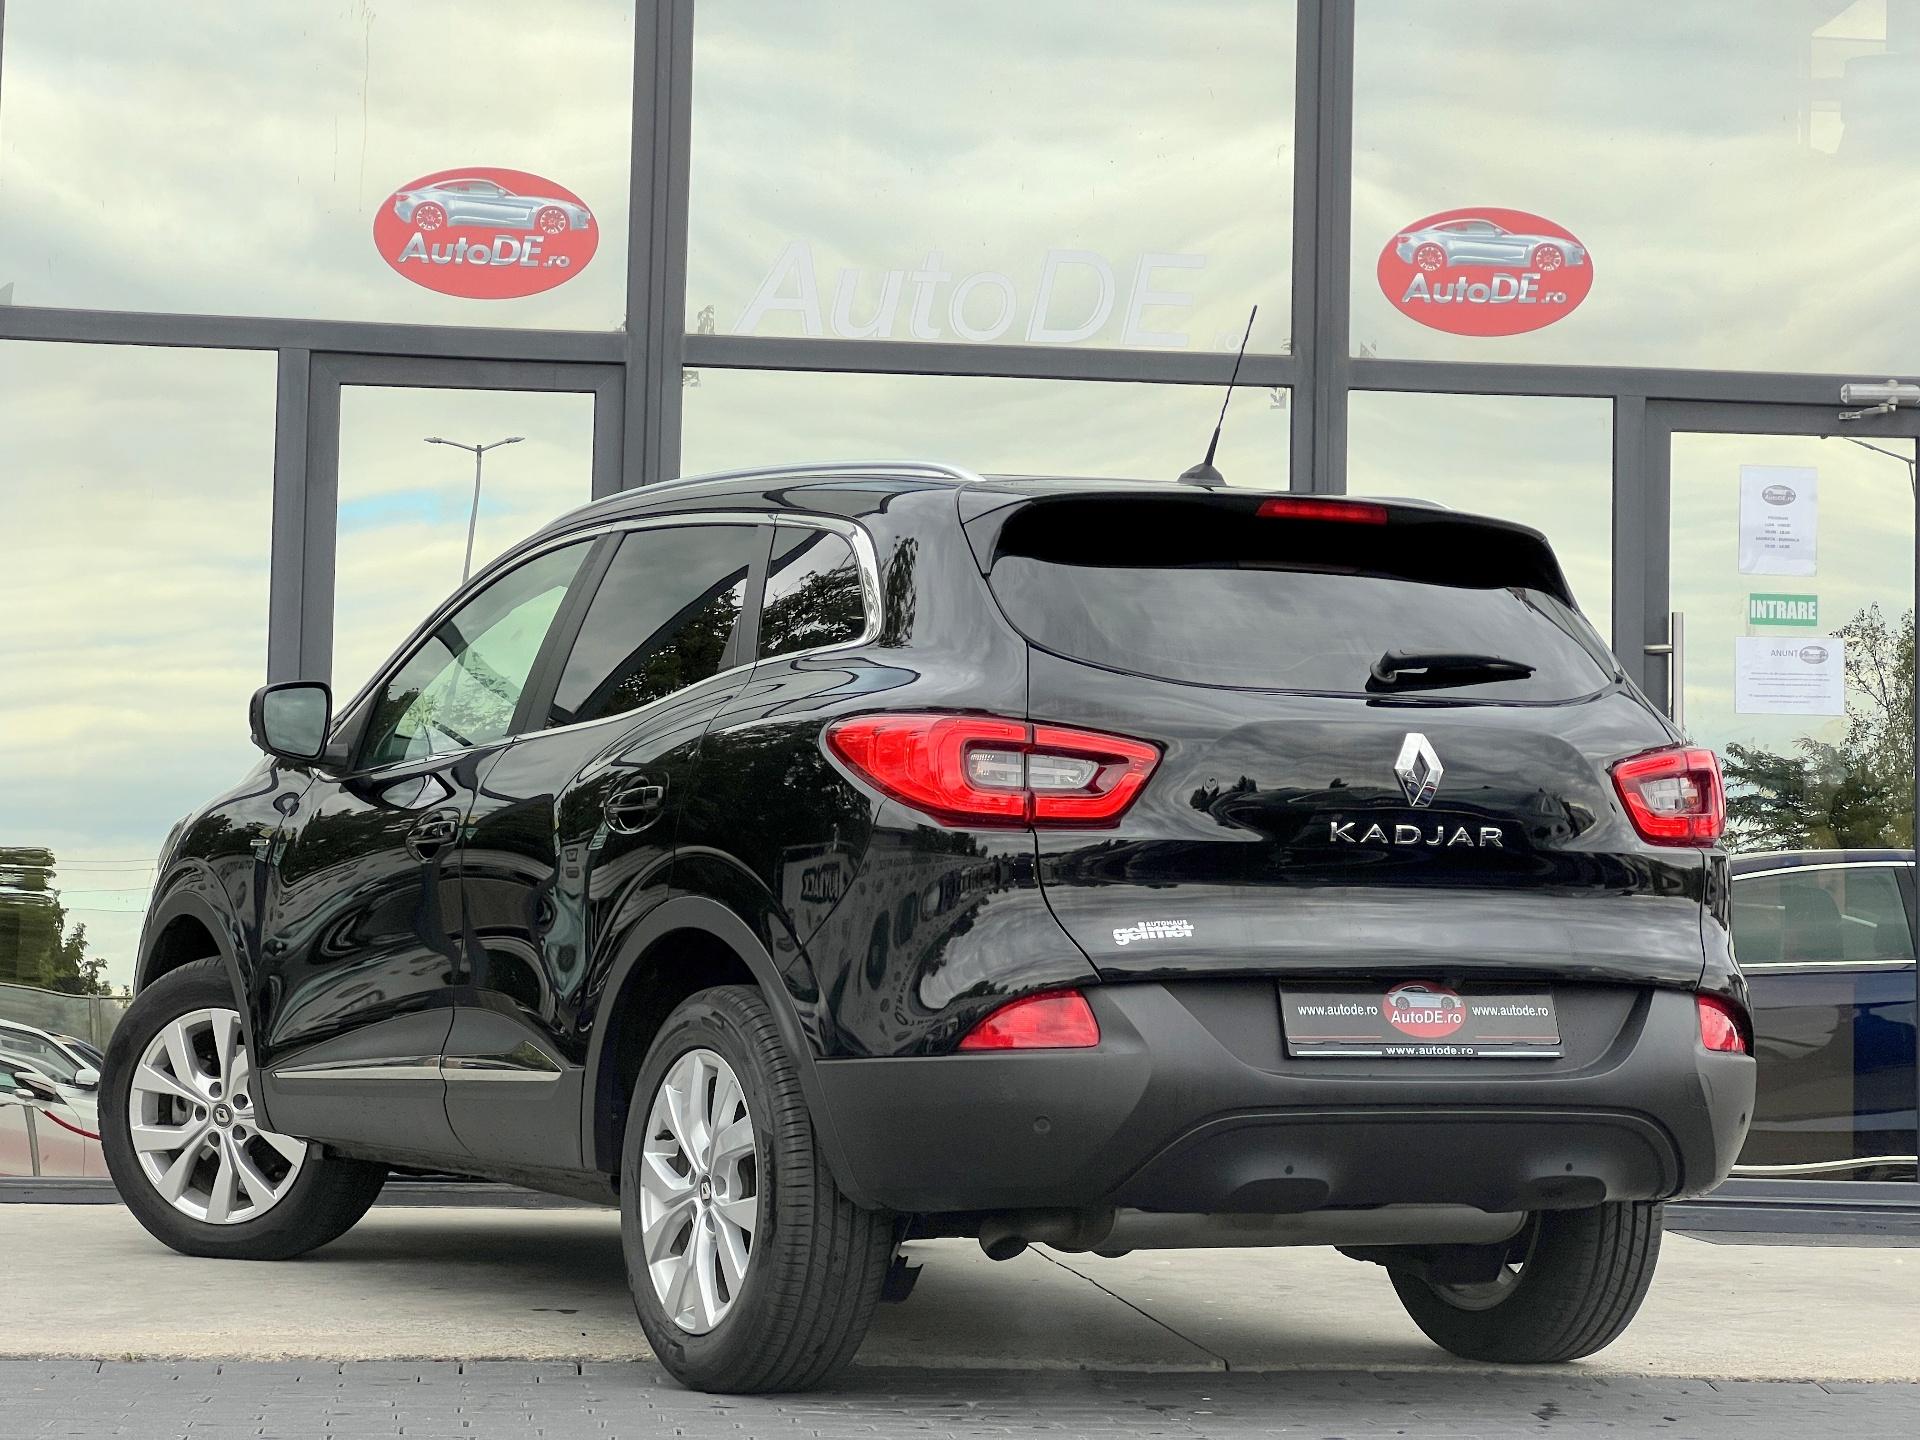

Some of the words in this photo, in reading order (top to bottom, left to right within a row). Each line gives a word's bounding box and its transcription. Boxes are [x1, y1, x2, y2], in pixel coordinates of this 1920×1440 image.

[398, 231, 570, 268] AutoDE.ro
[1401, 272, 1567, 304] AutoDE.ro
[1750, 600, 1817, 620] INTRARE
[1329, 821, 1504, 848] KADJAR
[1146, 919, 1188, 927] AUTOHAUS
[1297, 1004, 1378, 1016] www.autode.ro
[1391, 1010, 1462, 1024] AutoDE.ro
[1471, 1004, 1549, 1017] www.autode.ro
[1385, 1045, 1474, 1055] www.autode.ro
